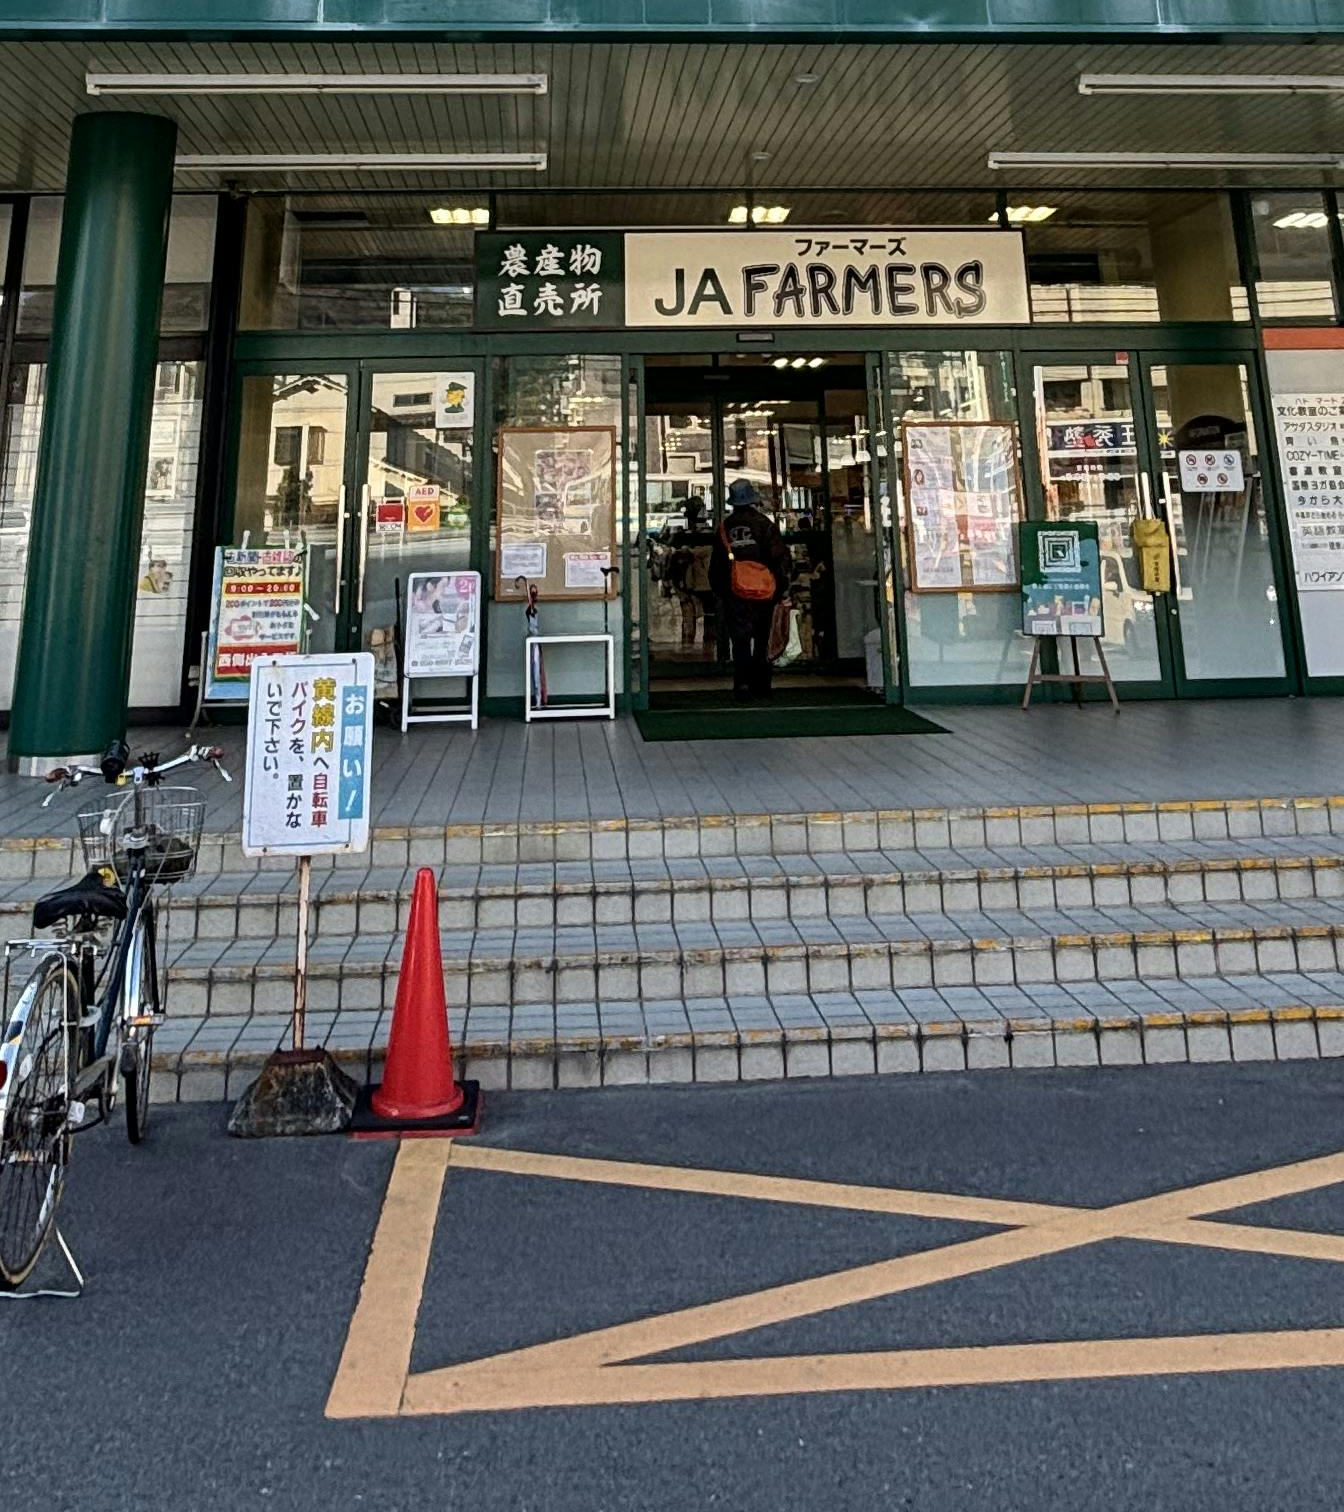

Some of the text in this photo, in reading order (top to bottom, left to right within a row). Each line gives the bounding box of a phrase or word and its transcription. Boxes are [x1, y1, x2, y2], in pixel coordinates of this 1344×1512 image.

[498, 243, 602, 277] 農産物
[794, 237, 907, 257] ファーマーズ
[498, 282, 603, 317] 直売所
[654, 259, 987, 319] JA FARMERS
[414, 487, 435, 496] AED
[310, 677, 338, 828] 黄線内へ自転車
